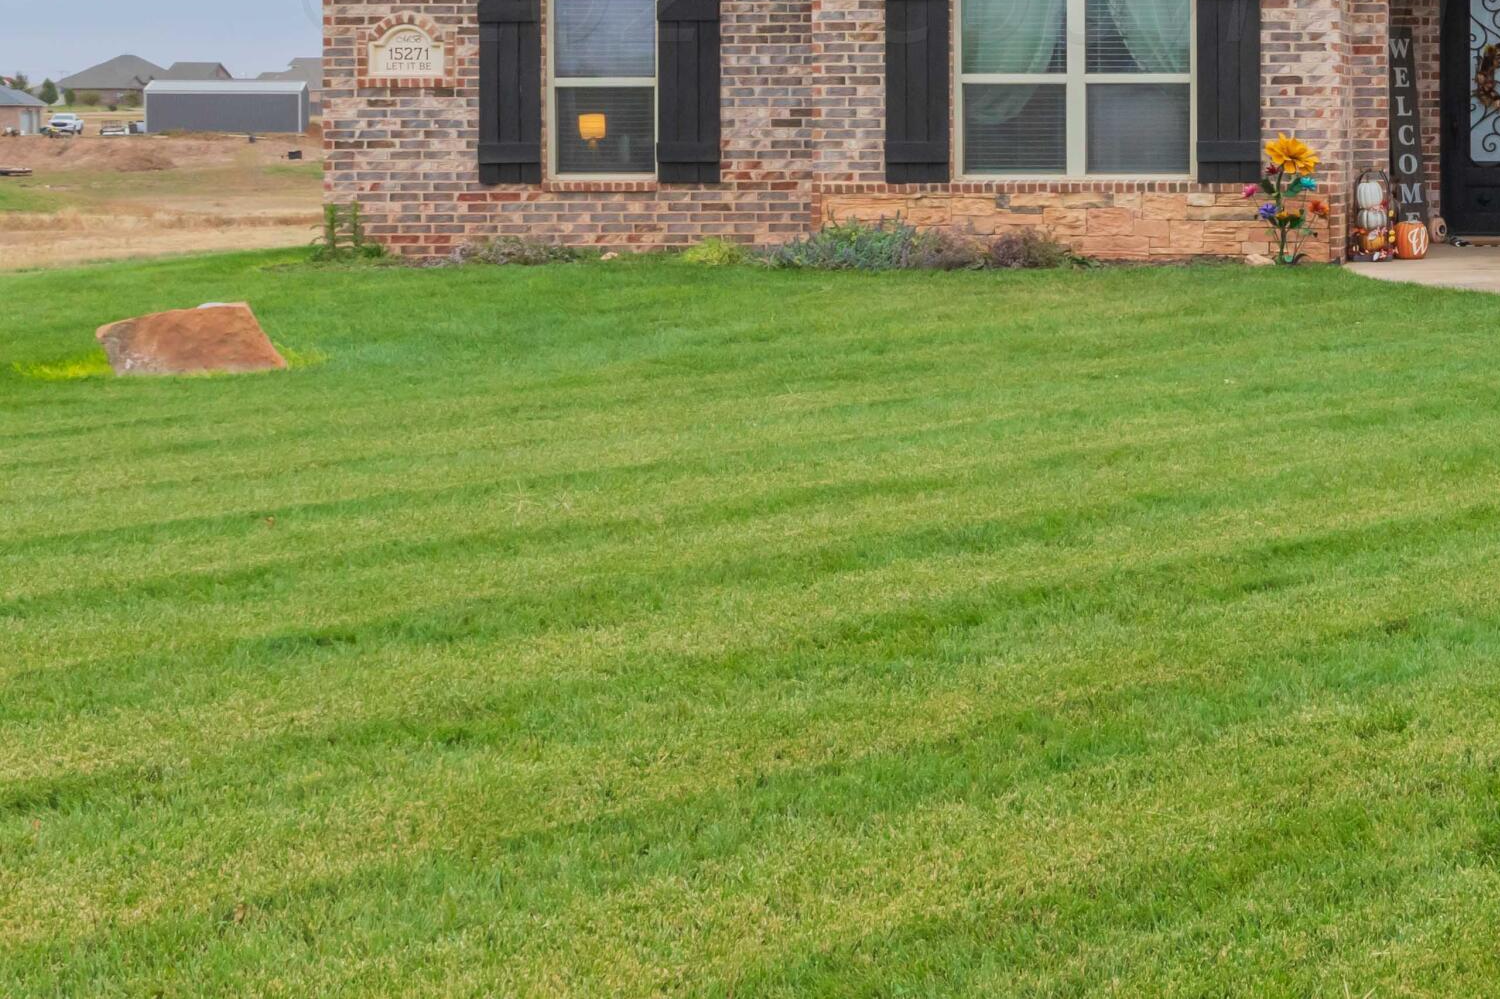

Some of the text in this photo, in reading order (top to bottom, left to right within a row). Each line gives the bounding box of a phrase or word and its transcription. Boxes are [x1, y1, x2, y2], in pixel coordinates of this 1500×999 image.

[388, 47, 429, 61] 15271
[386, 62, 432, 71] LET IT BE
